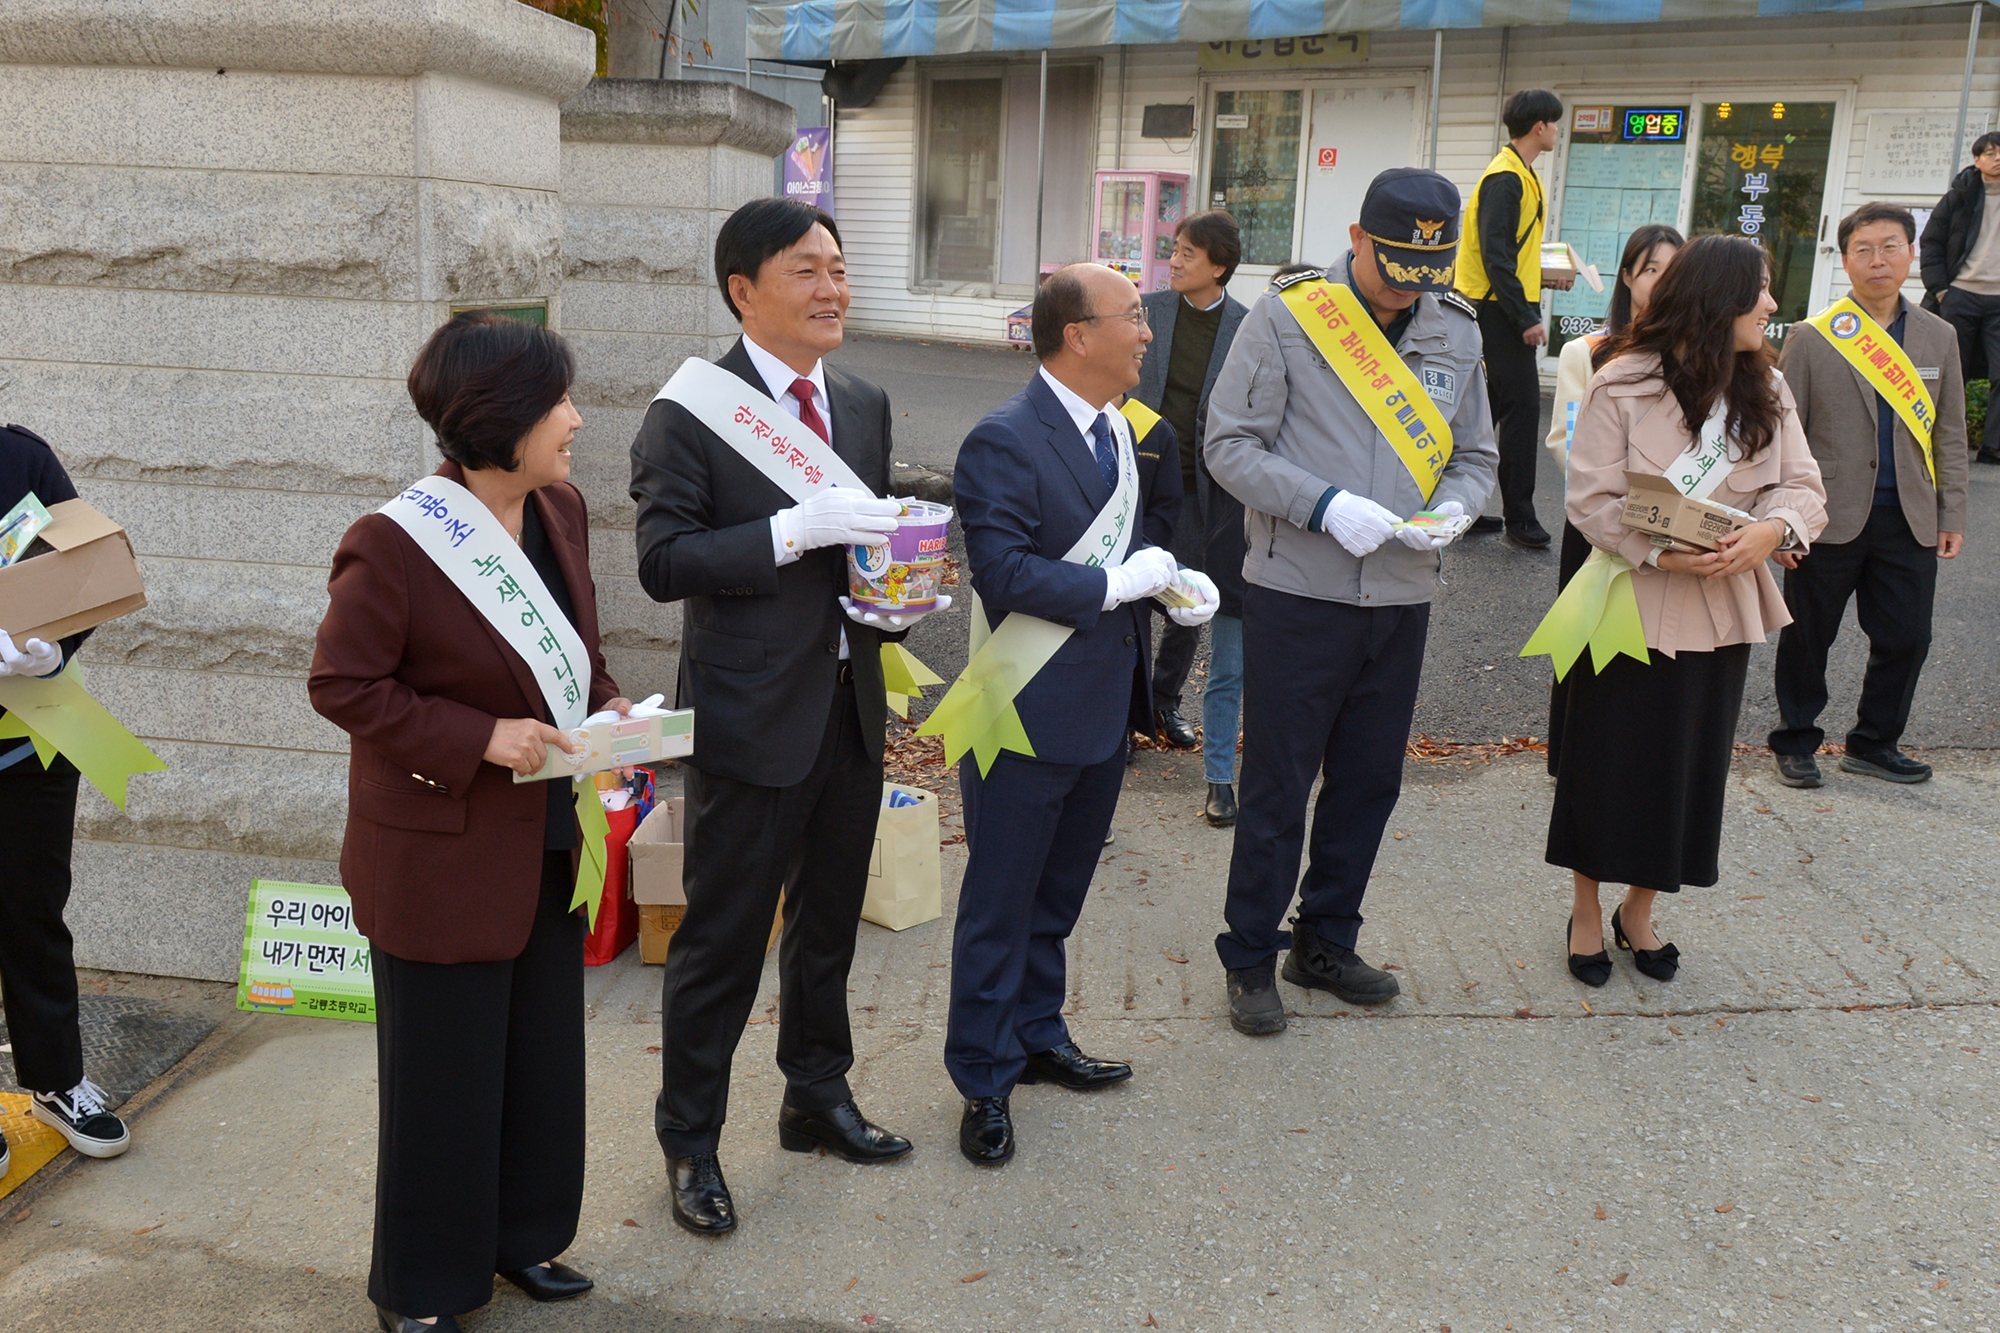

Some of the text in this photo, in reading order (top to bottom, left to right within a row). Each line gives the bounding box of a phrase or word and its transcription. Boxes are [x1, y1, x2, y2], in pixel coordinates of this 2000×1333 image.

[1629, 114, 1678, 135] 영업중
[1731, 143, 1784, 170] 행복
[787, 181, 822, 195] 아이스크림
[1737, 172, 1770, 245] 부동
[1306, 287, 1349, 330] 어린이
[1339, 330, 1394, 391] 보호구역
[1427, 371, 1453, 390] 경찰
[1853, 333, 1917, 401] 교통법규
[1428, 387, 1453, 400] POLICE
[734, 405, 824, 485] 안전운전을
[1681, 434, 1728, 496] 녹색어
[1647, 505, 1660, 525] 3
[918, 537, 948, 552] HARIB
[471, 553, 582, 711] 녹색어머니회
[266, 899, 351, 931] 우리 아이
[262, 941, 371, 974] 내가 먼저 서
